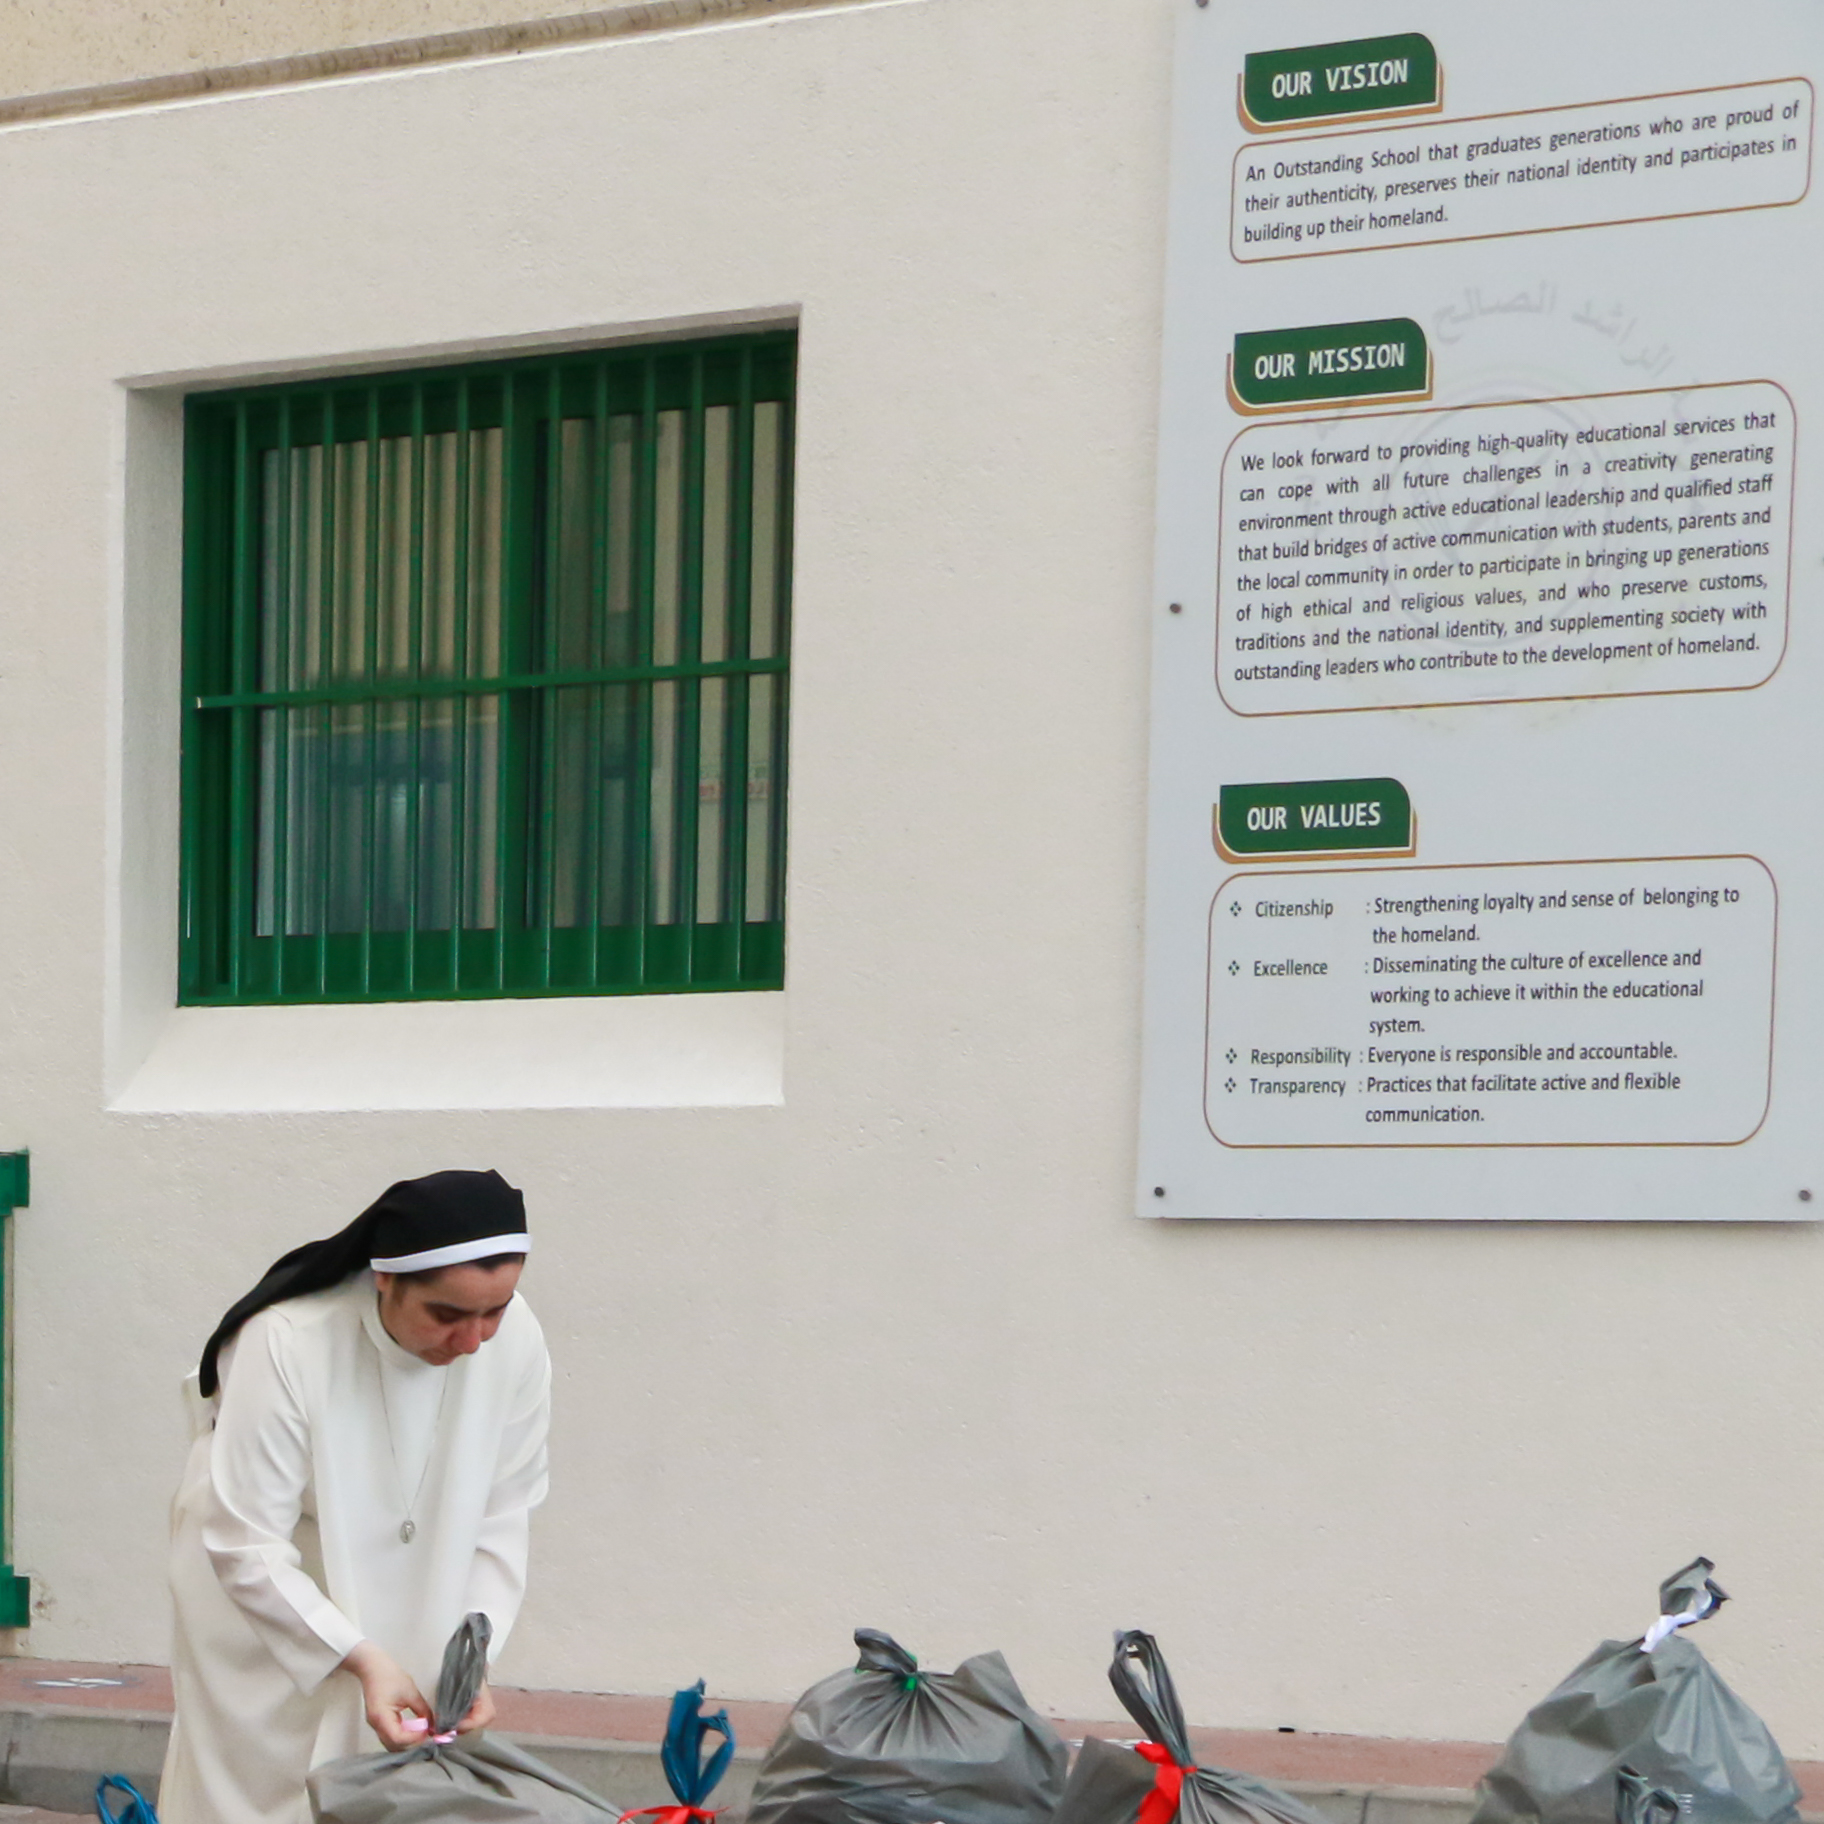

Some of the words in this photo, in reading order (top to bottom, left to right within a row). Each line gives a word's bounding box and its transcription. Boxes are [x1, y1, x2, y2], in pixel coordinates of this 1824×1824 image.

[1271, 67, 1312, 99] OUR
[1325, 58, 1409, 93] VISION
[1245, 162, 1266, 183] An
[1273, 152, 1364, 184] Outstanding
[1371, 145, 1420, 167] School
[1427, 140, 1459, 161] that
[1465, 131, 1542, 161] graduates
[1549, 119, 1641, 151] generations
[1649, 113, 1684, 135] who
[1691, 115, 1717, 130] are
[1725, 103, 1774, 131] proud
[1782, 99, 1800, 119] of
[1245, 191, 1280, 212] their
[1286, 181, 1378, 212] authenticity,
[1384, 177, 1457, 201] preserves
[1463, 166, 1500, 187] their
[1506, 158, 1570, 182] national
[1576, 151, 1637, 180] identity
[1644, 146, 1674, 167] and
[1680, 136, 1775, 167] participates
[1782, 132, 1797, 151] in
[1243, 218, 1302, 247] building
[1306, 221, 1326, 241] up
[1329, 212, 1365, 233] their
[1368, 204, 1448, 229] homeland.
[1254, 351, 1296, 380] OUR
[1307, 342, 1406, 376] MISSION
[1240, 452, 1265, 471] We
[1272, 449, 1304, 469] look
[1310, 443, 1370, 465] forward
[1376, 441, 1393, 460] to
[1399, 435, 1470, 463] providing
[1477, 427, 1569, 456] high-quality
[1575, 419, 1666, 443] educational
[1673, 413, 1735, 435] services
[1743, 409, 1776, 429] that
[1239, 488, 1265, 502] can
[1277, 484, 1313, 504] cope
[1325, 475, 1359, 495] with
[1372, 472, 1390, 491] all
[1402, 467, 1449, 488] future
[1462, 460, 1541, 489] challenges
[1554, 457, 1569, 476] in
[1581, 461, 1591, 474] a
[1604, 449, 1678, 477] creativity
[1689, 442, 1774, 470] generating
[1238, 507, 1333, 531] environment
[1338, 502, 1397, 529] through
[1402, 498, 1446, 519] active
[1451, 491, 1540, 515] educational
[1545, 484, 1625, 513] leadership
[1630, 481, 1659, 501] and
[1664, 476, 1733, 504] qualified
[1737, 472, 1773, 493] staff
[1246, 804, 1288, 832] OUR
[1300, 800, 1382, 829] VALUES
[1255, 897, 1334, 923] Citizenship
[1374, 892, 1480, 919] Strengthening
[1483, 890, 1534, 915] loyalty
[1538, 889, 1567, 908] and
[1571, 893, 1614, 907] sense
[1618, 887, 1635, 906] of
[1643, 884, 1719, 910] belonging
[1723, 884, 1740, 902] to
[1372, 925, 1397, 943] the
[1401, 923, 1480, 942] homeland.
[1253, 957, 1328, 976] Excellence
[1372, 953, 1477, 978] Disseminating
[1481, 952, 1506, 970] the
[1510, 951, 1564, 969] culture
[1568, 950, 1585, 968] of
[1587, 948, 1668, 967] excellence
[1672, 947, 1702, 965] and
[1370, 984, 1430, 1009] working
[1434, 983, 1450, 1002] to
[1453, 982, 1511, 1001] achieve
[1515, 982, 1526, 1000] it
[1530, 980, 1578, 999] within
[1582, 980, 1608, 998] the
[1612, 978, 1703, 997] educational
[1369, 1014, 1425, 1039] system.
[1250, 1045, 1351, 1070] Responsibility
[1367, 1044, 1436, 1068] Everyone
[1440, 1043, 1451, 1061] is
[1455, 1042, 1542, 1066] responsible
[1546, 1042, 1575, 1060] and
[1579, 1040, 1677, 1059] accountable.
[1249, 1074, 1346, 1099] Transparency
[1367, 1073, 1432, 1092] Practices
[1436, 1073, 1467, 1091] that
[1471, 1072, 1537, 1091] facilitate
[1541, 1072, 1587, 1090] active
[1591, 1071, 1620, 1090] and
[1624, 1071, 1681, 1089] flexible
[1365, 1103, 1484, 1122] communication.
